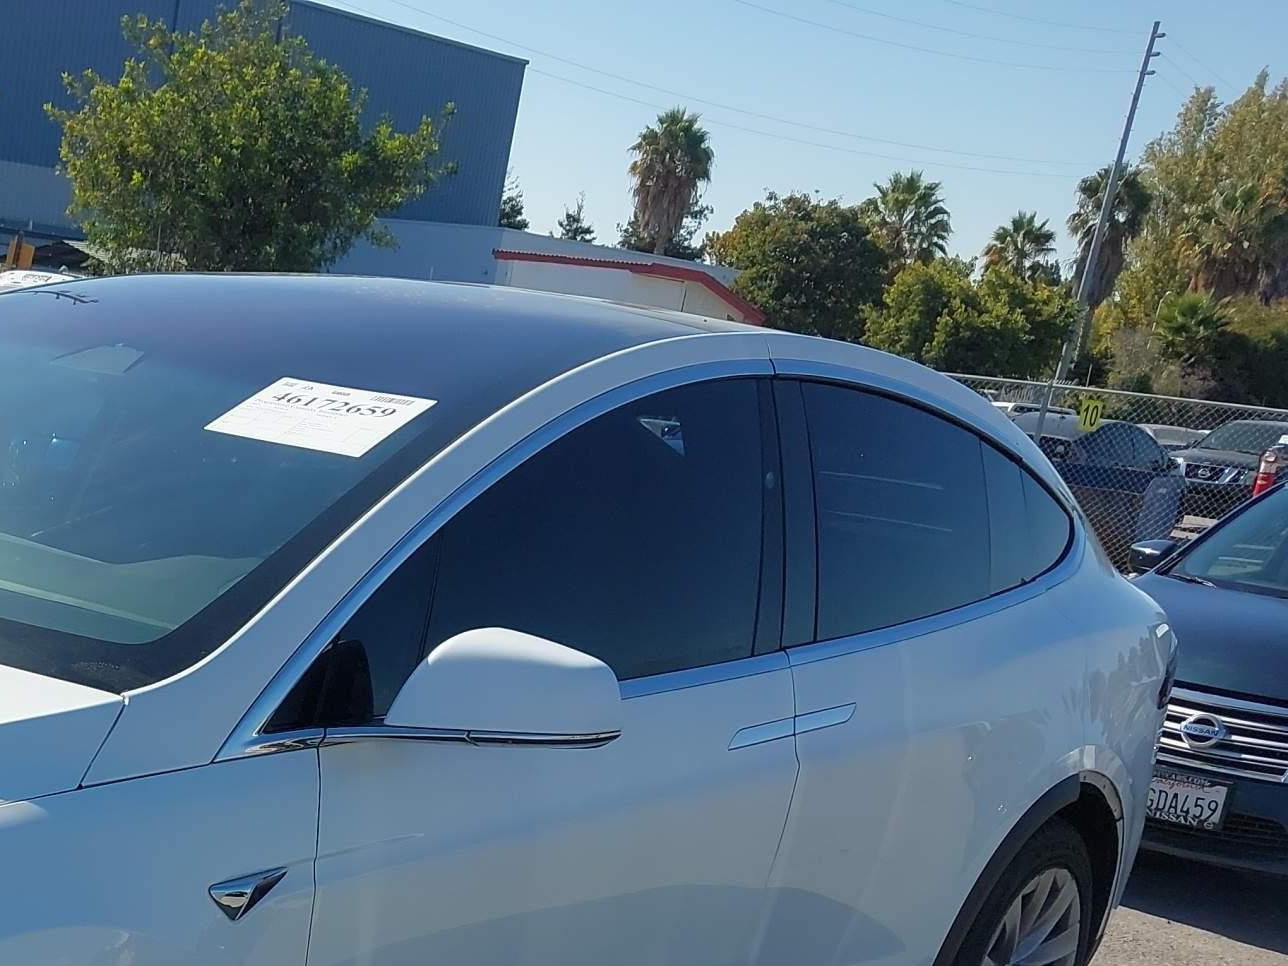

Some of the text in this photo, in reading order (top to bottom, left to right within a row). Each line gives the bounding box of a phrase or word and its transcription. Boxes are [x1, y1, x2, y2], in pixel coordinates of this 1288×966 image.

[272, 392, 397, 417] 46172659
[1083, 404, 1099, 427] 10
[1183, 724, 1219, 737] NISSAN
